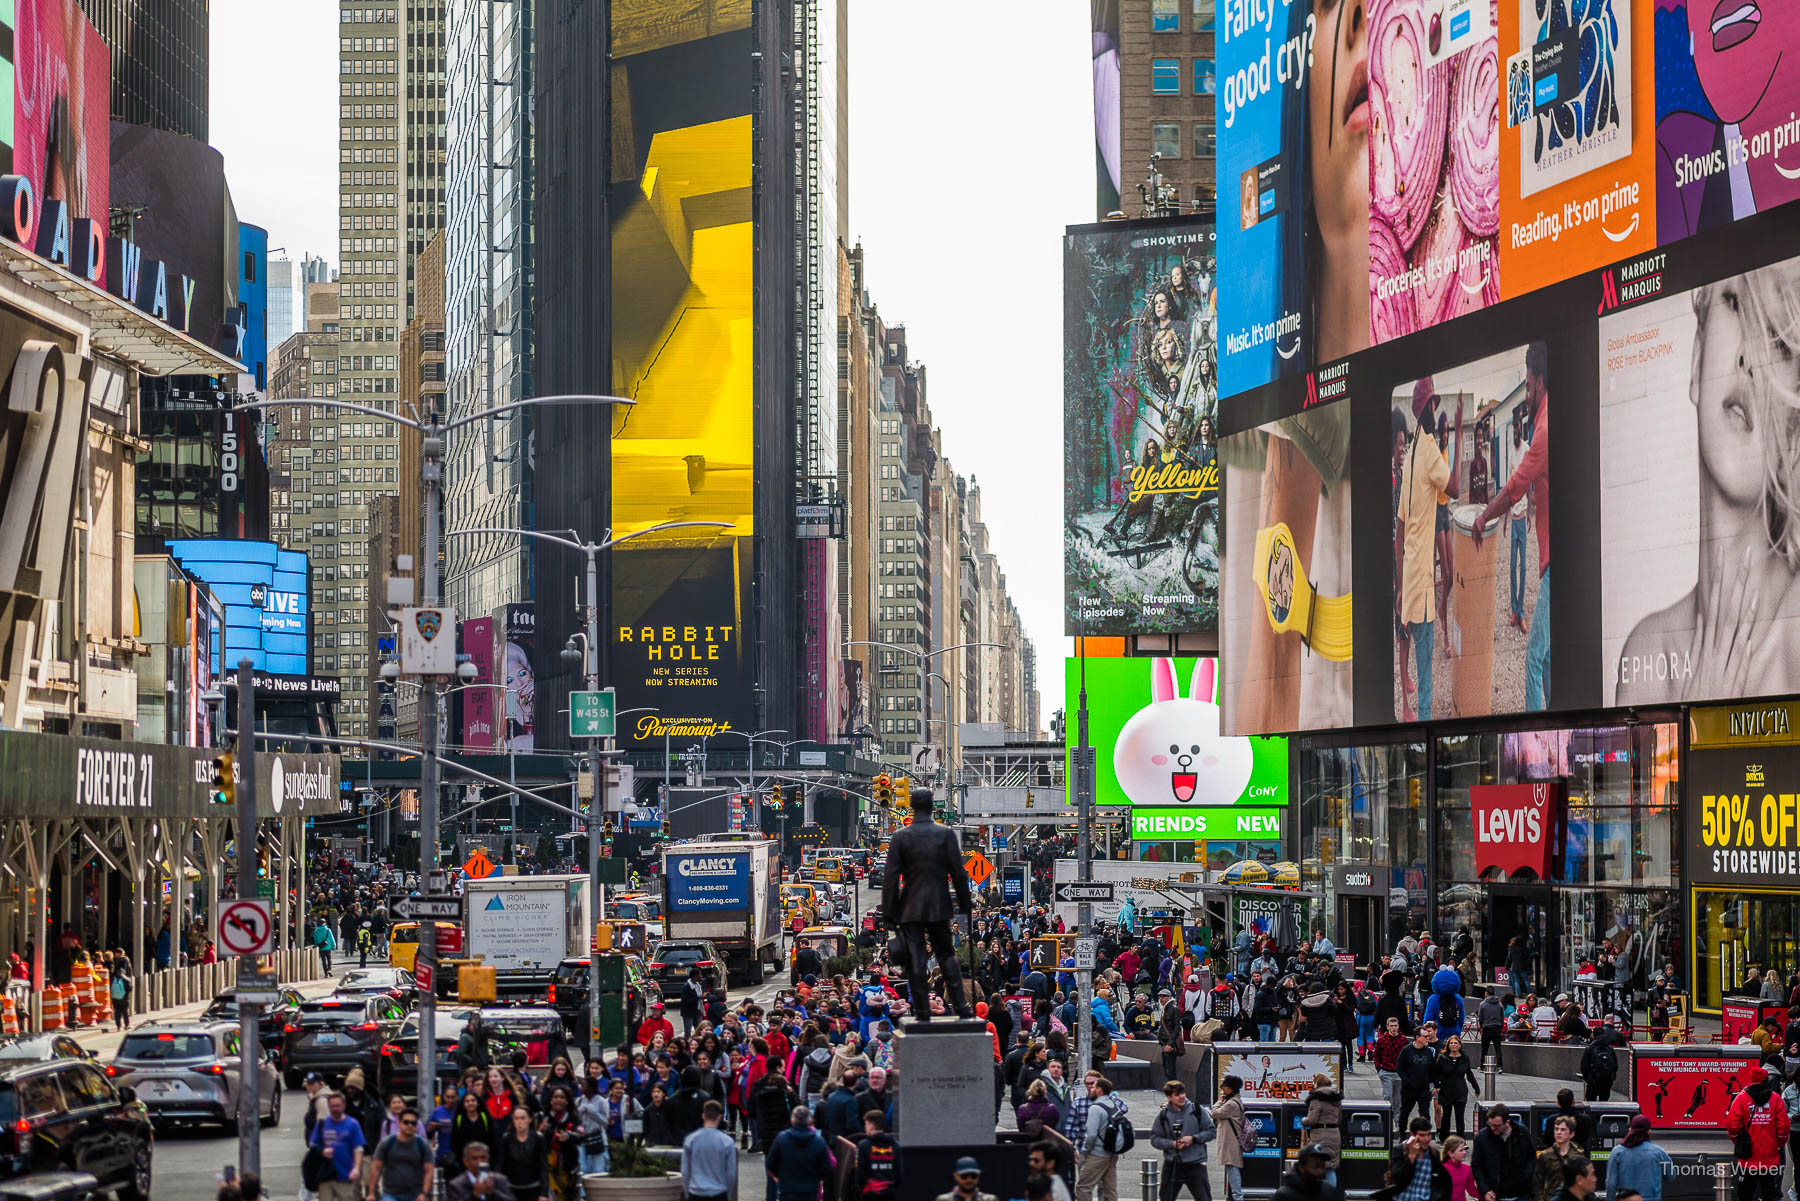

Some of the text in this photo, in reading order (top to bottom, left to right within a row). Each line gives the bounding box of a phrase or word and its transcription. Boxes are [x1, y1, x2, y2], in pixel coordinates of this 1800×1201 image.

[1224, 0, 1274, 43] Fancy
[1224, 13, 1316, 128] good cry?
[1536, 128, 1618, 172] HEATHER CHRISTLE
[1675, 149, 1725, 188] Shows.
[1728, 133, 1749, 167] It's
[1752, 131, 1770, 159] on
[1512, 182, 1640, 250] Reading. It's on prime
[1144, 234, 1204, 246] SHOWTIME
[1377, 239, 1491, 300] Groceries. It's on prime
[1621, 254, 1666, 281] MARRIOTT
[1621, 276, 1661, 302] MARQUIS
[1226, 310, 1300, 356] Music. It's on prime
[1608, 334, 1624, 352] Global
[1319, 362, 1350, 383] MARRIOTT
[1319, 379, 1346, 400] MARQUIS
[221, 412, 238, 492] 1500
[251, 588, 263, 600] abc
[1143, 594, 1195, 606] Streaming
[1143, 606, 1165, 616] Now
[620, 626, 733, 642] RABBIT
[648, 644, 719, 660] HOLE
[653, 667, 709, 676] NEW SERIES
[1612, 650, 1693, 684] SEPHORA
[274, 678, 308, 691] News
[586, 696, 599, 706] TO
[576, 709, 609, 717] W 45 St
[1729, 707, 1790, 738] INVICTA
[76, 748, 153, 807] FOREVER 21
[285, 762, 318, 810] sunglass
[318, 762, 331, 800] hut
[1236, 816, 1279, 832] NEW
[1702, 794, 1755, 847] 50%
[678, 858, 736, 876] CLANCY
[1713, 850, 1800, 876] STOREWIDE!
[1346, 872, 1368, 886] swatch
[400, 904, 454, 913] ONE WAY
[678, 898, 739, 906] ClancyMoving.com
[1244, 1081, 1313, 1091] BLACK-TIE
